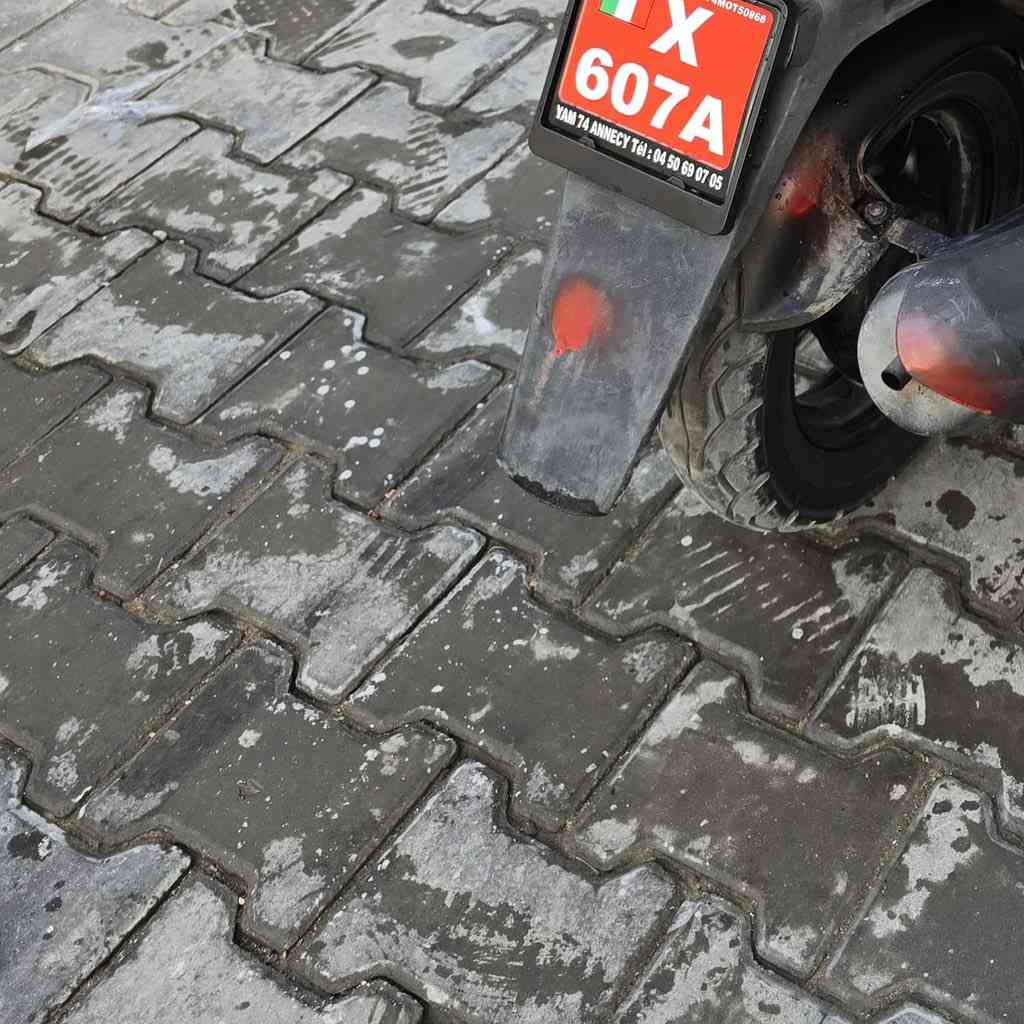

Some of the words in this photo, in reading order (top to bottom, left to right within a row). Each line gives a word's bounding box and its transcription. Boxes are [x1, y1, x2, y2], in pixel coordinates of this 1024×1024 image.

[556, 103, 577, 126] YAM
[577, 113, 590, 131] 74
[589, 120, 631, 149] ANNECY
[653, 148, 667, 166] 04
[666, 154, 680, 171] 50
[681, 160, 695, 177] 69
[695, 167, 709, 184] 07
[708, 173, 724, 191] 05
[575, 47, 724, 156] 607A
